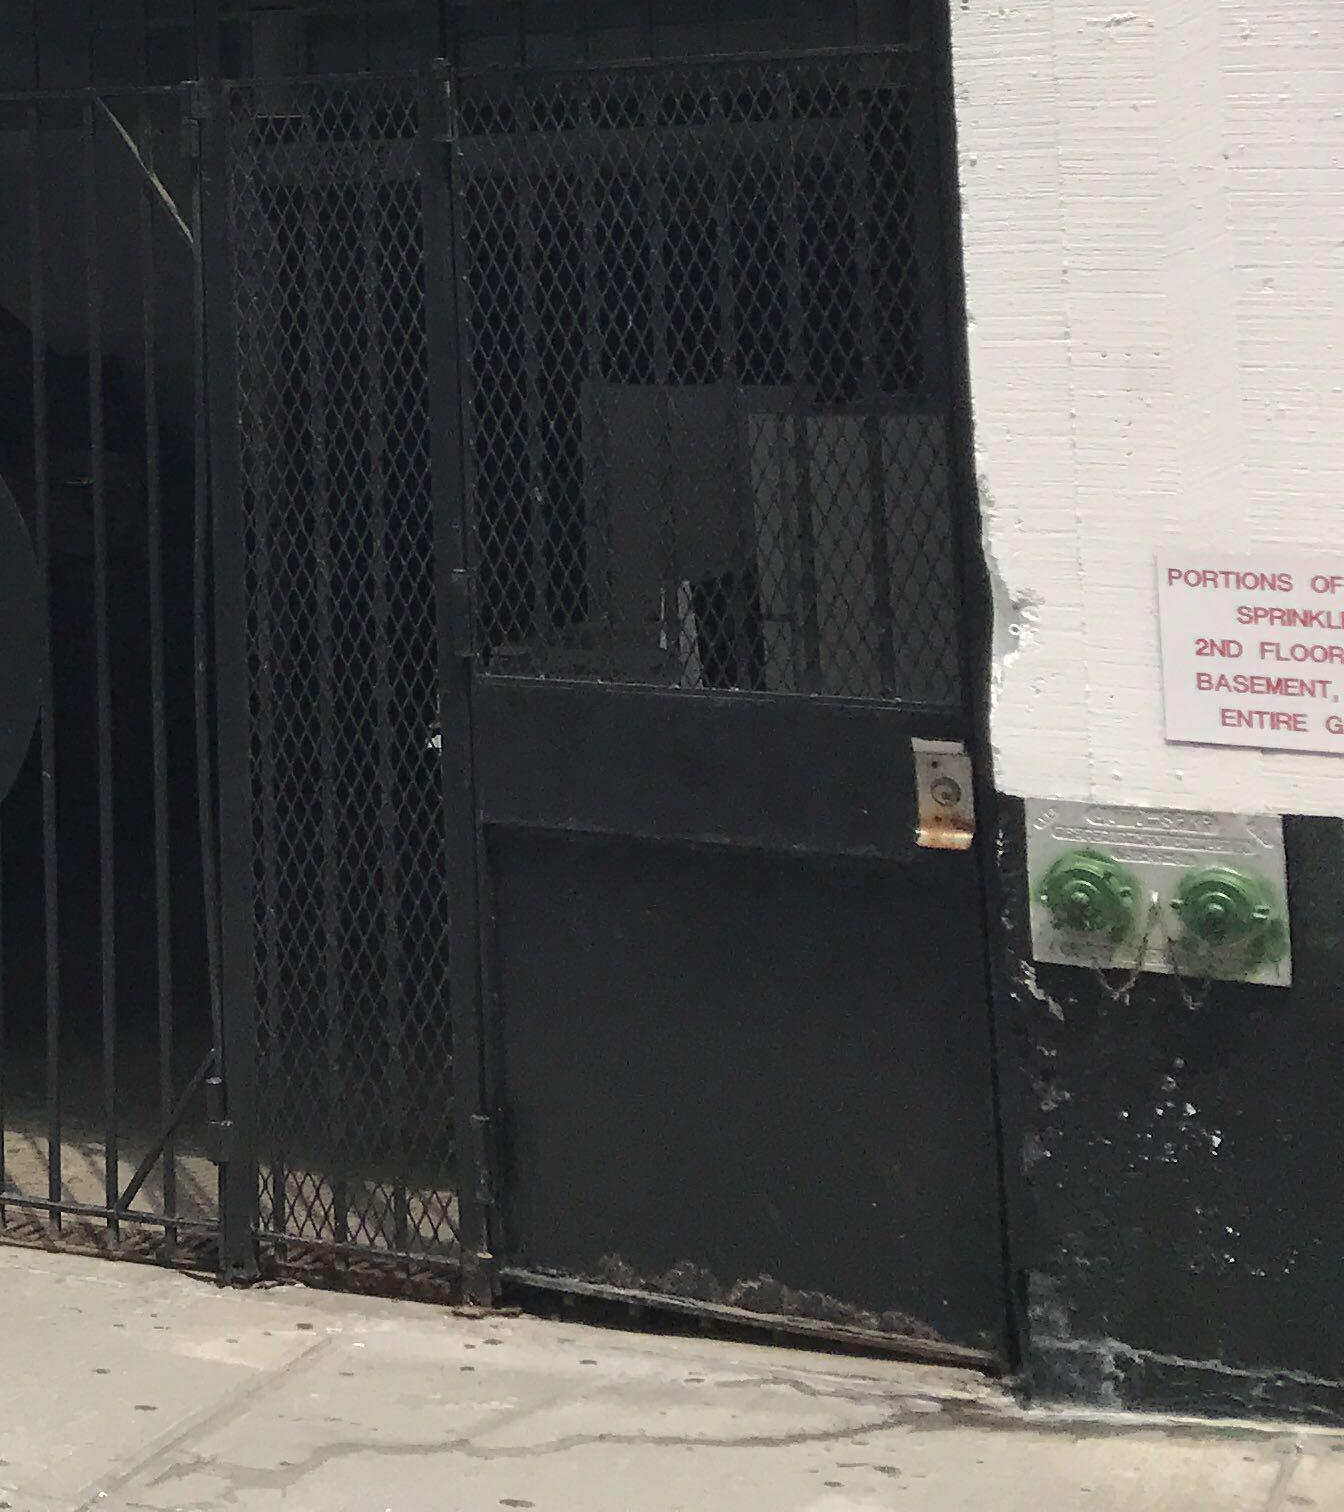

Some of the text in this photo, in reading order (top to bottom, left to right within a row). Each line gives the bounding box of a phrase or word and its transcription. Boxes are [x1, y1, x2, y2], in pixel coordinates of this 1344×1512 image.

[1167, 568, 1344, 595] PORTIONS OF
[1236, 605, 1344, 630] SPRINKL
[1195, 638, 1344, 664] 2ND FLOOR
[1196, 672, 1340, 703] BASEMENT,
[1220, 708, 1308, 732] ENTIRE
